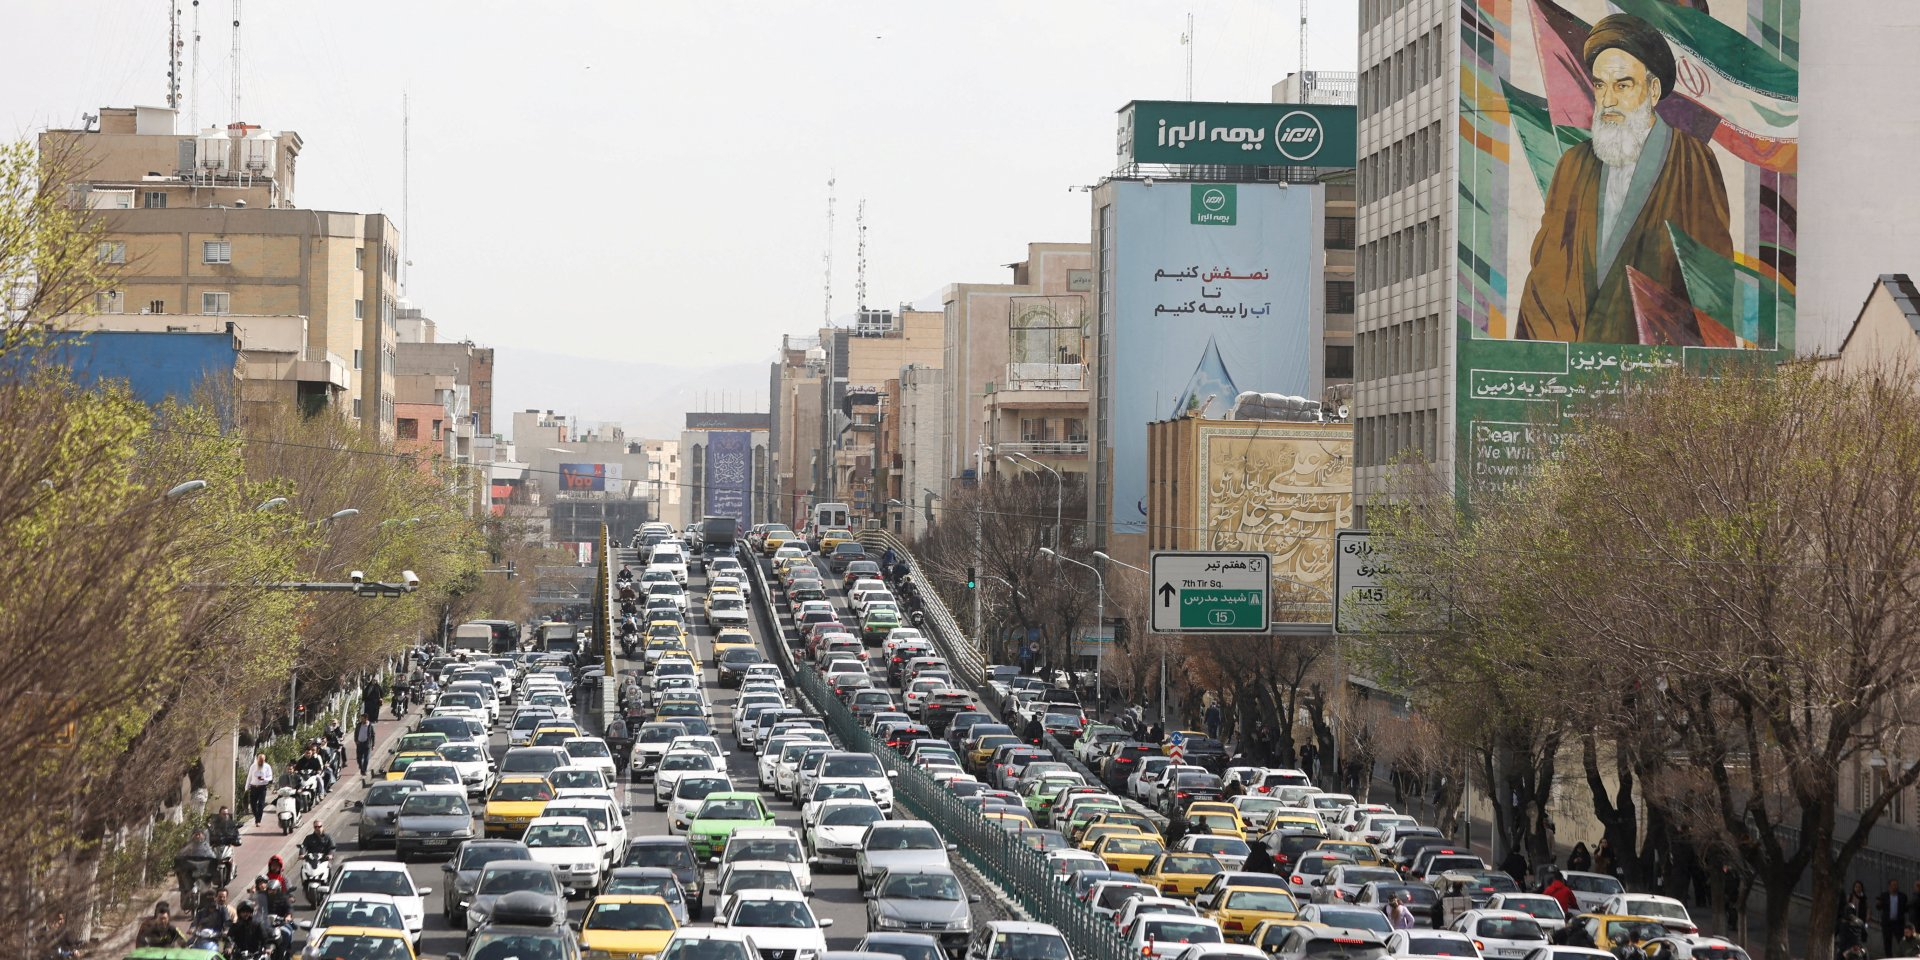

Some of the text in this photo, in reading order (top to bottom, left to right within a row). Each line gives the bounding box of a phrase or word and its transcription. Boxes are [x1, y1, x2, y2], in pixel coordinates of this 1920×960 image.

[1158, 118, 1206, 149] البرز
[1210, 127, 1265, 150] بیمه
[1154, 265, 1269, 282] نصفش کنیم
[1201, 286, 1221, 298] تا
[1154, 300, 1271, 318] آب را بیمه کنیم
[1476, 376, 1515, 395] زمین
[1517, 380, 1534, 397] به
[1477, 425, 1520, 443] Dear
[1477, 445, 1500, 459] We
[1476, 462, 1518, 476] Down
[1204, 560, 1247, 573] هفتم تیر
[1182, 580, 1223, 589] 7th Tir Sq.
[1184, 593, 1247, 605] شهید مدرس
[1215, 611, 1228, 623] 15
